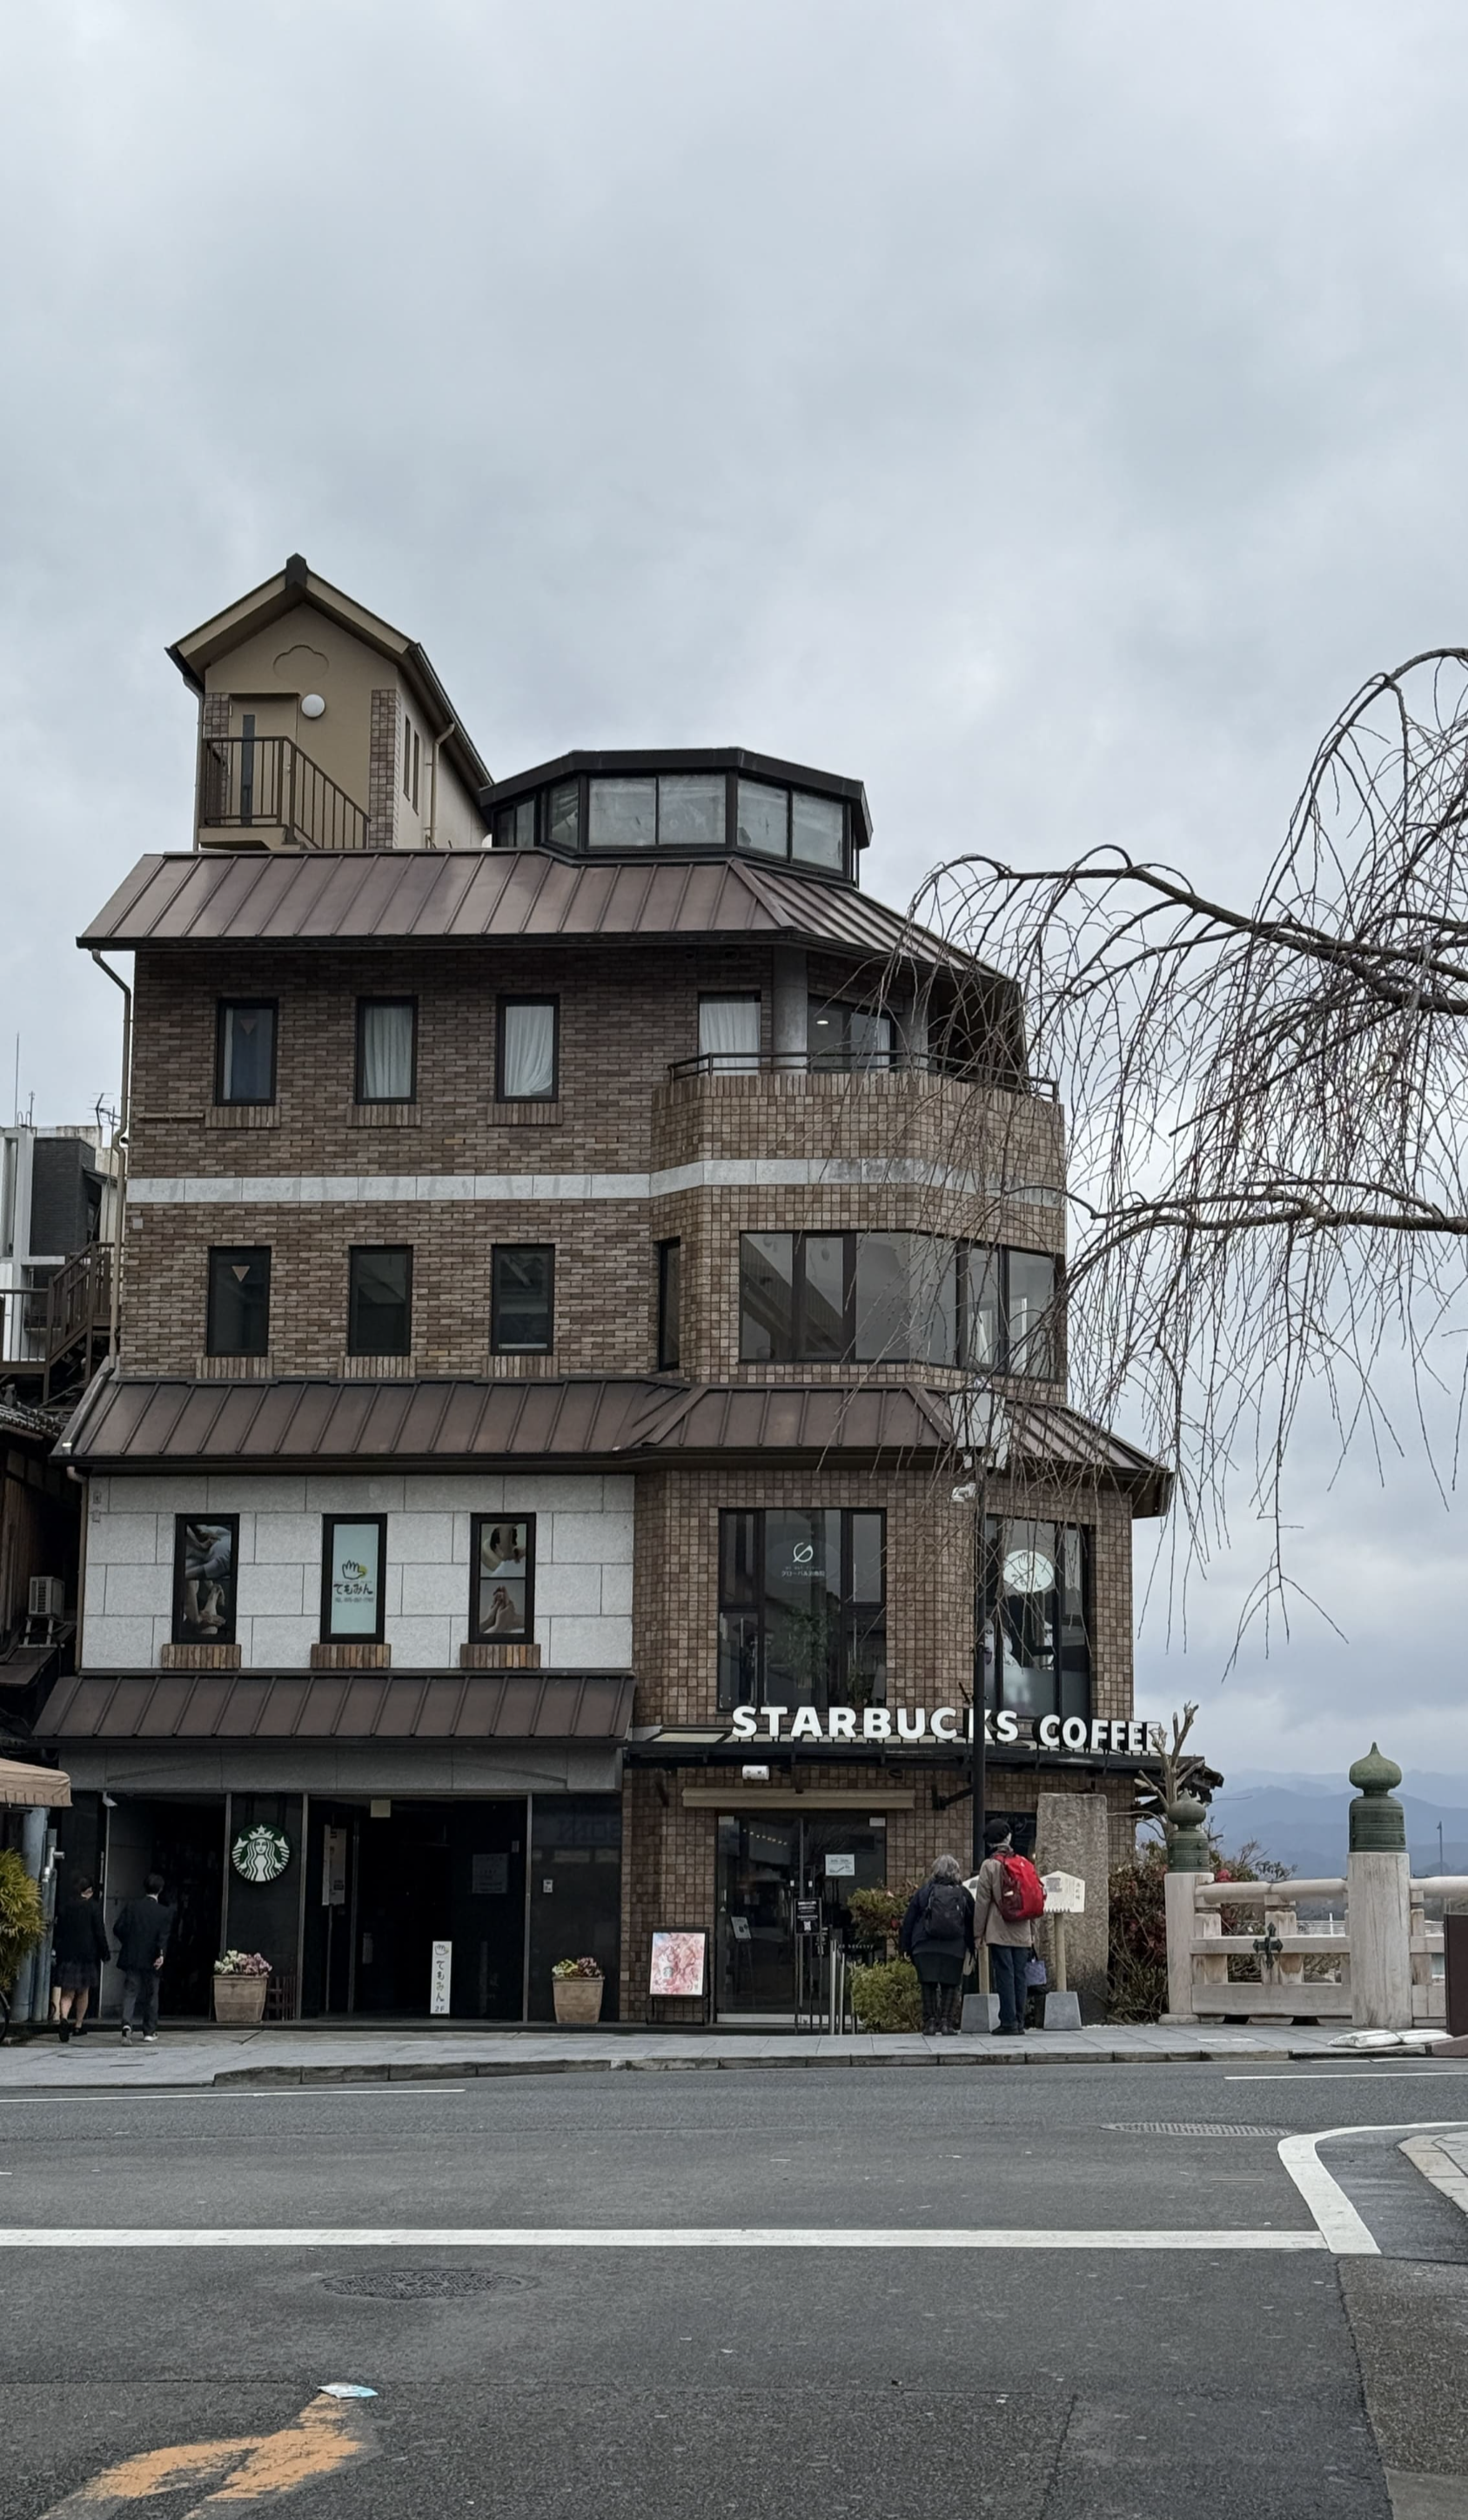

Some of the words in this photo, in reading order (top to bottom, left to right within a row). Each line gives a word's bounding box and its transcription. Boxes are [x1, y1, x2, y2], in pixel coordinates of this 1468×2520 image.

[333, 1583, 373, 1595] てもみん
[732, 1705, 1019, 1742] STARBUCKS
[1039, 1713, 1163, 1752] COFFEE
[436, 1960, 446, 2002] てもみん
